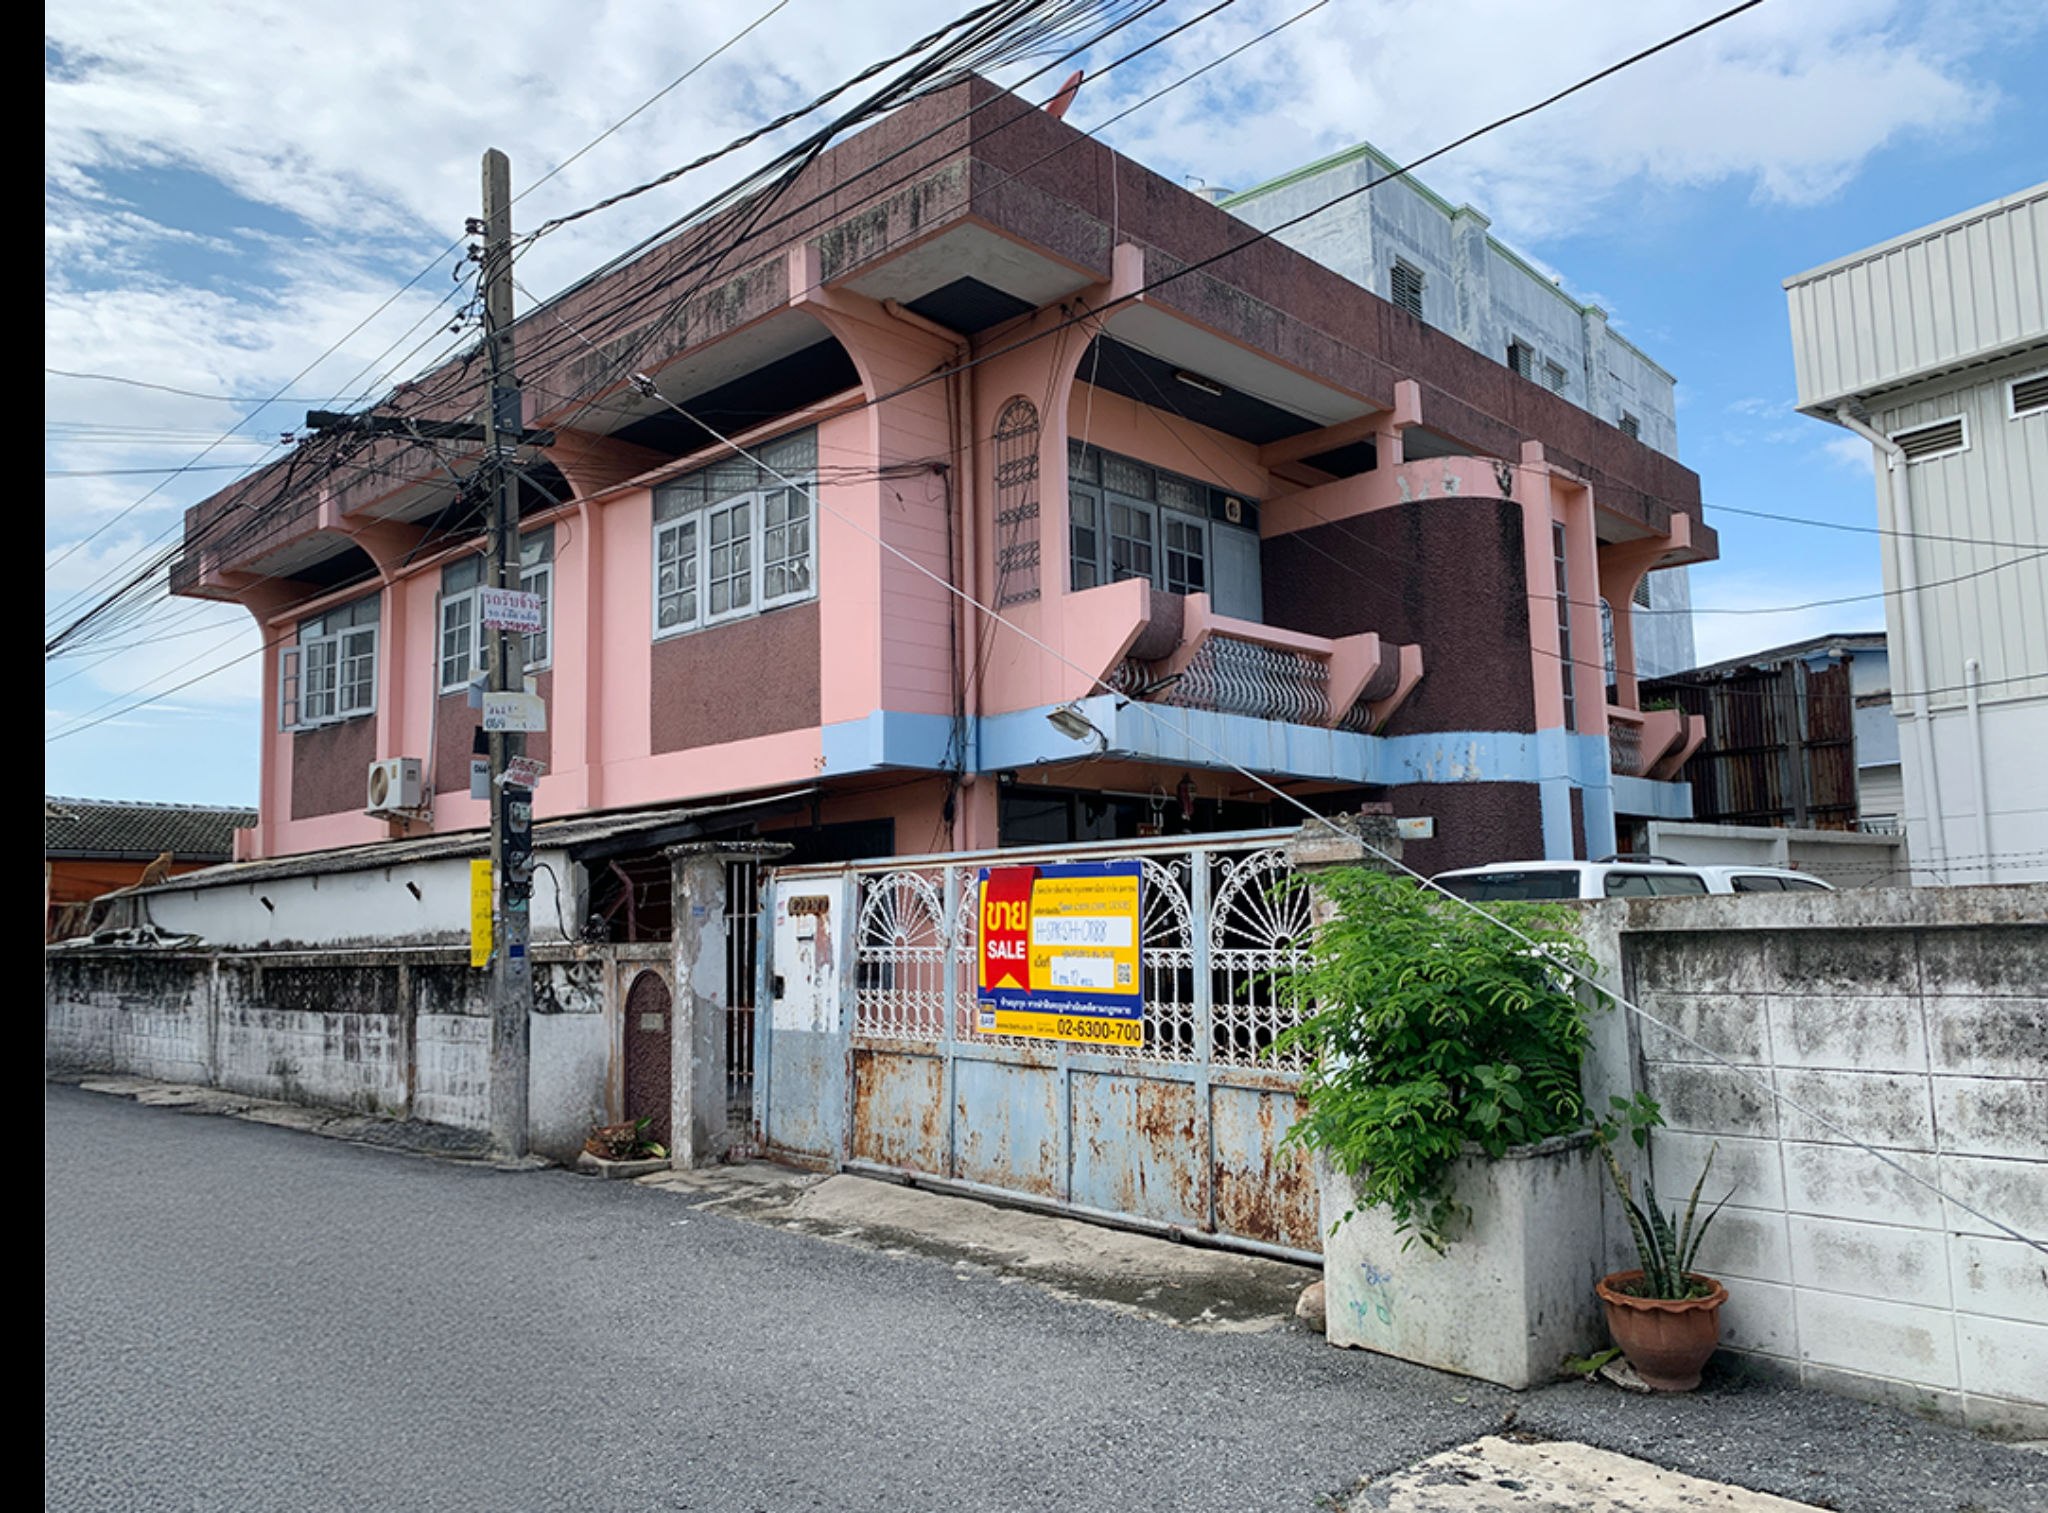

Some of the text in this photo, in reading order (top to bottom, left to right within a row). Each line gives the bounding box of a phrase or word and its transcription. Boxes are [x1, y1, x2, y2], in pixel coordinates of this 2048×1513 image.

[987, 900, 1026, 931] ขาย
[987, 939, 1026, 959] SALE
[1057, 1018, 1141, 1042] 02-6300-700
